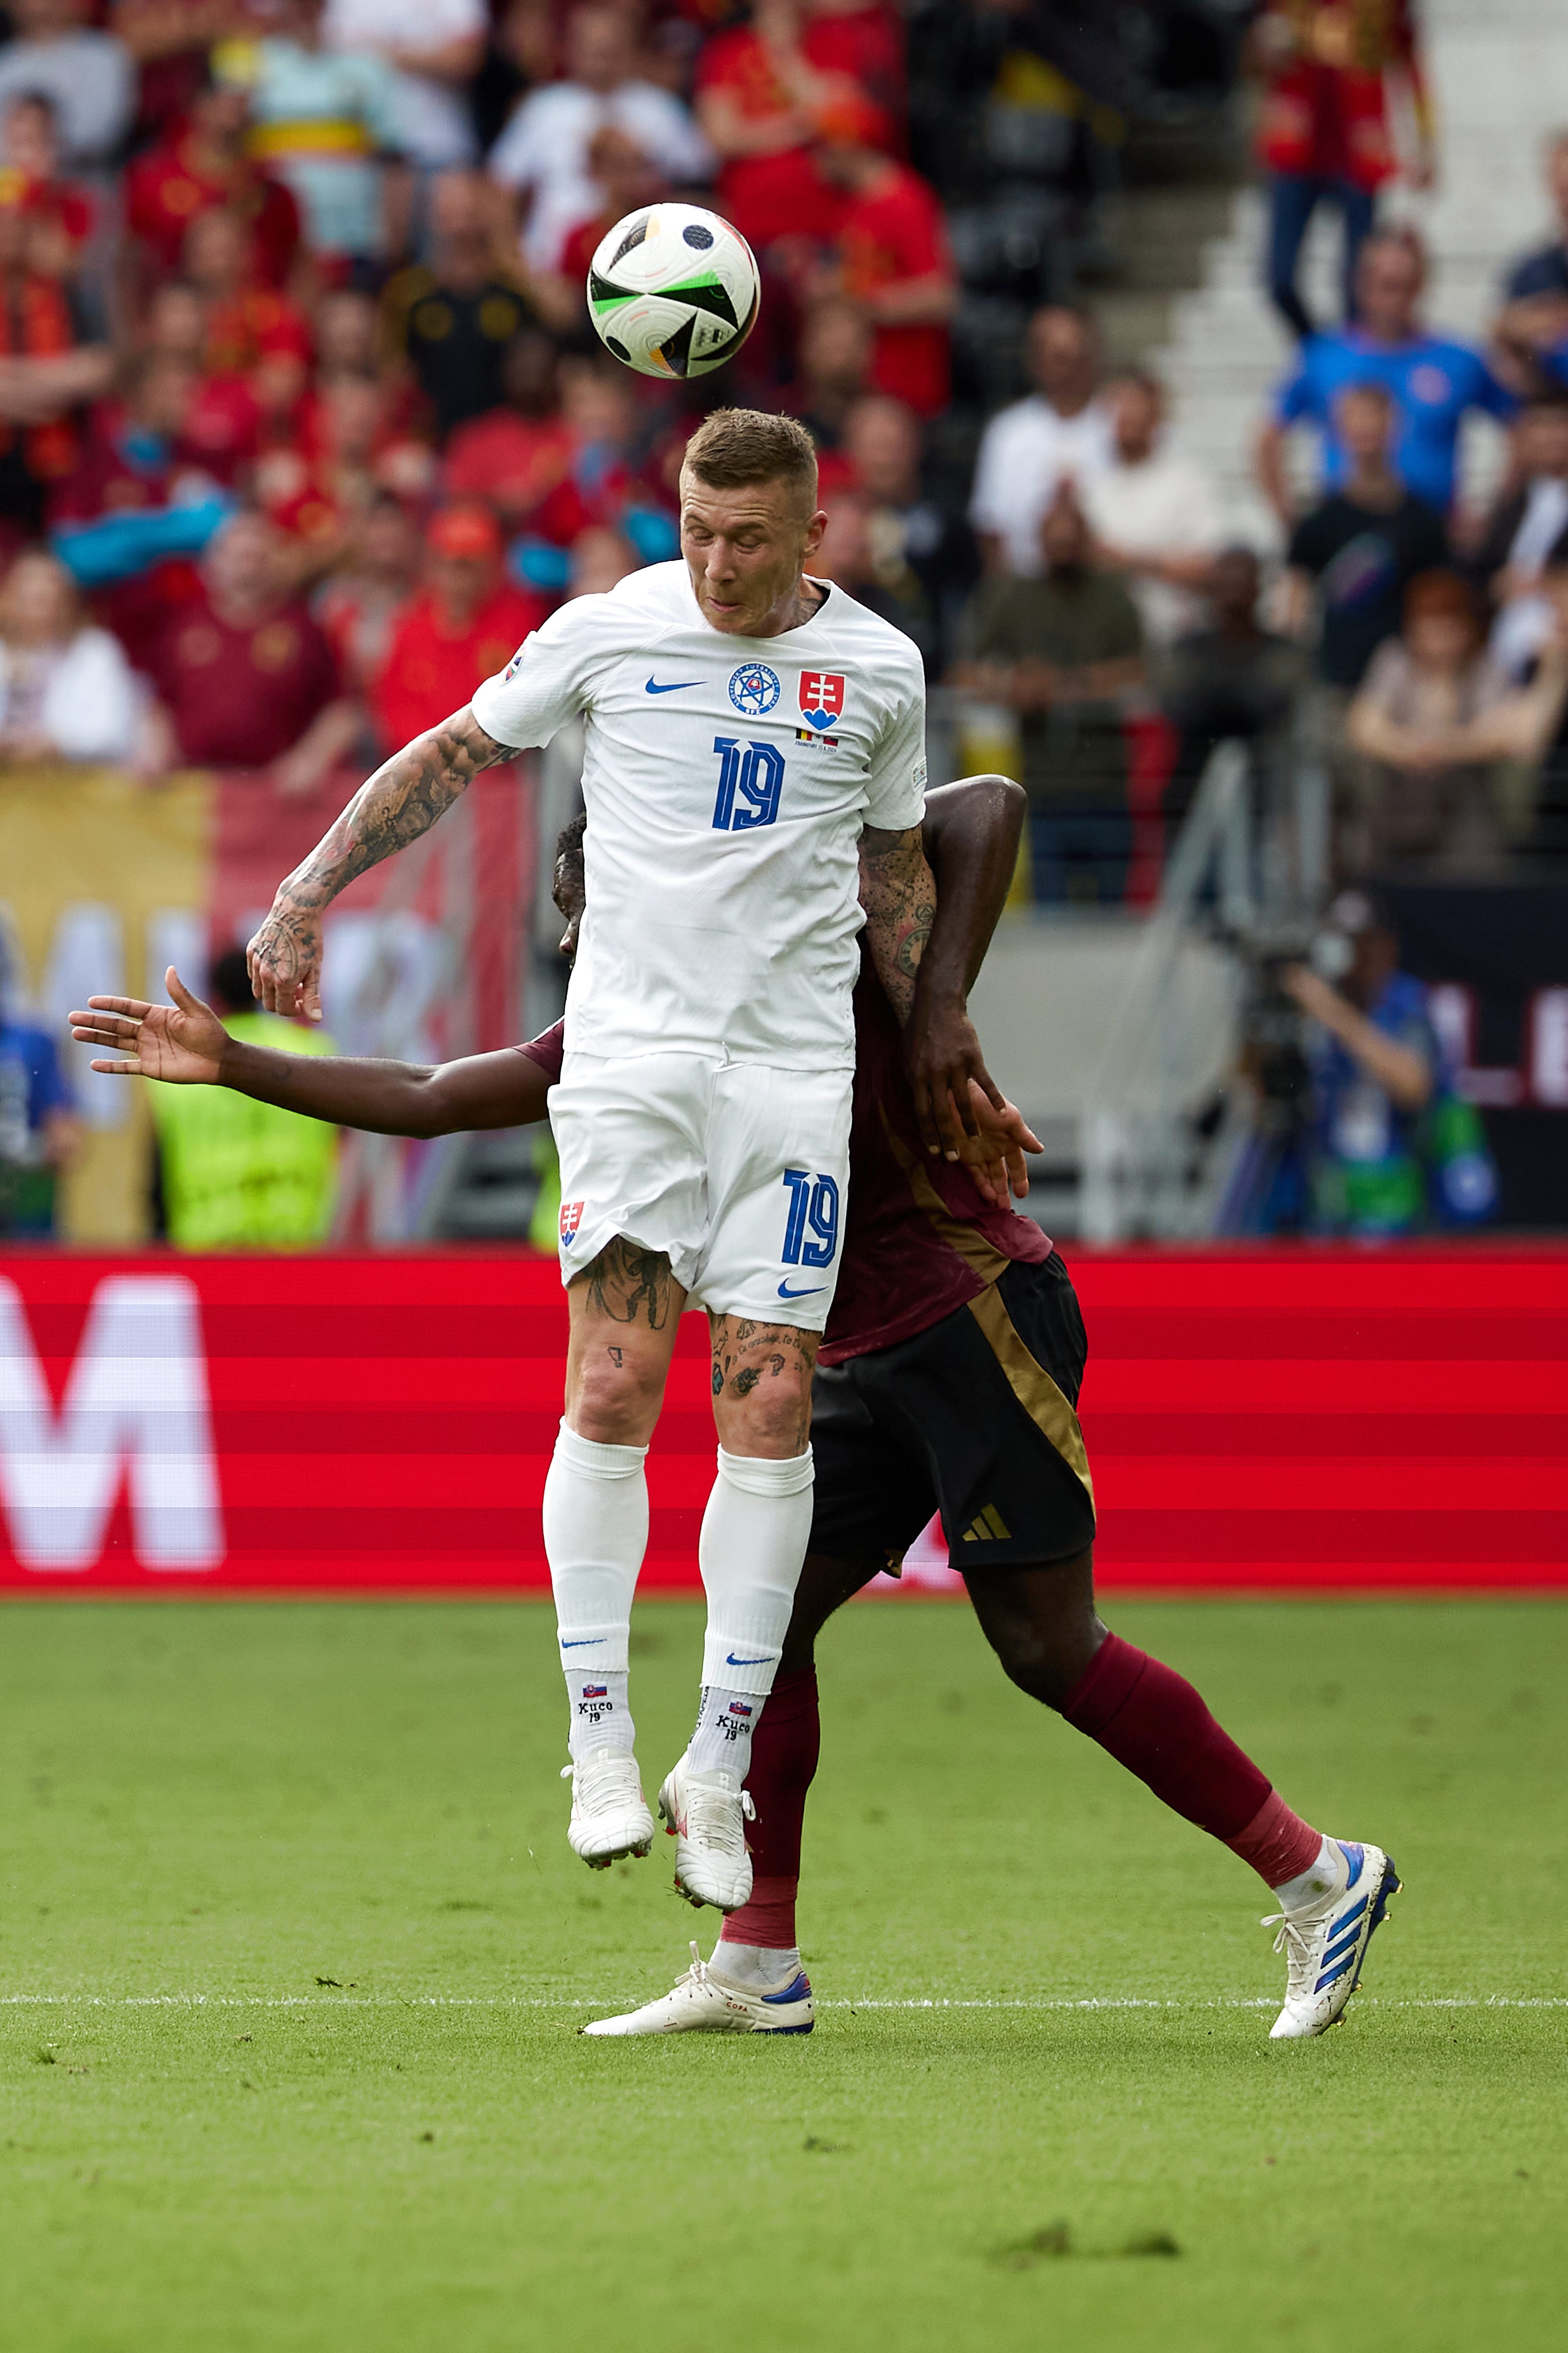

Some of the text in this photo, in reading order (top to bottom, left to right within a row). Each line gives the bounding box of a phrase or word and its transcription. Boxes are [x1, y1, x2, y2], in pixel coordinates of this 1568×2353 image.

[712, 736, 785, 831] 19
[781, 1168, 840, 1268] 19
[578, 1702, 613, 1714] Kuco
[589, 1712, 600, 1723] 19
[715, 1714, 751, 1733] Kuco
[724, 1729, 737, 1741] 19
[726, 2001, 748, 2012] COPA
